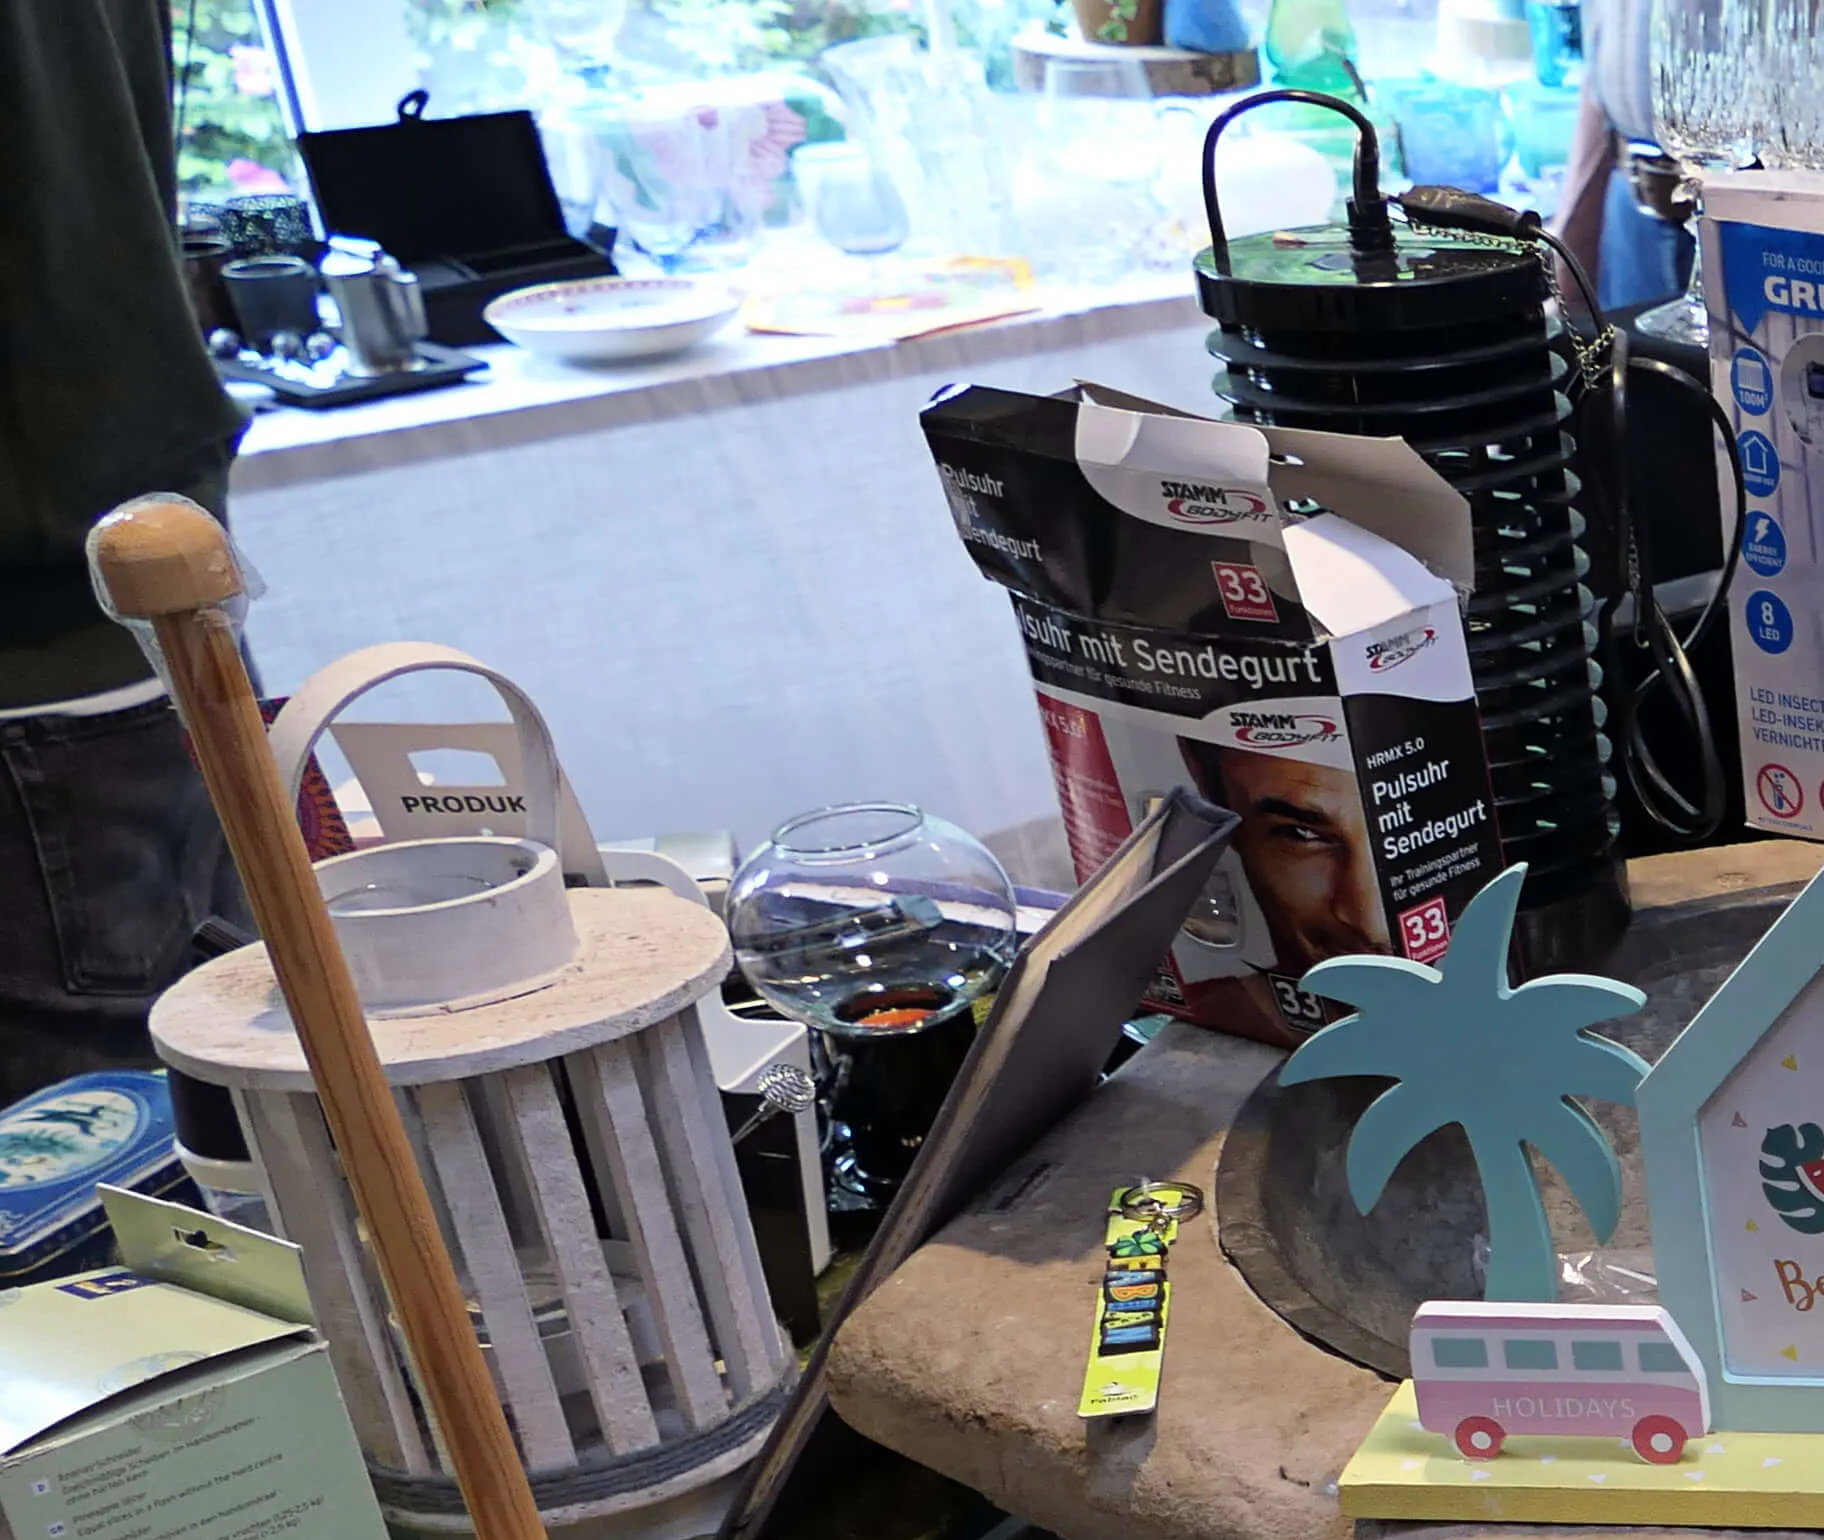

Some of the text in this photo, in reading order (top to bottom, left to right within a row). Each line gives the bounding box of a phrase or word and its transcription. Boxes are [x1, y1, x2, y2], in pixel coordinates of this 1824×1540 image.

[1762, 252, 1785, 269] FOR
[1787, 256, 1796, 270] A
[1161, 481, 1228, 505] STAMM
[1186, 503, 1274, 524] BODYFIT
[1218, 568, 1268, 603] 33
[1761, 601, 1774, 625] 8
[1759, 627, 1780, 642] LED
[1079, 634, 1127, 669] mit
[1133, 640, 1320, 690] Sendegurt
[1155, 680, 1201, 701] Fitness
[1750, 687, 1775, 705] LED
[1230, 712, 1296, 729] STAMM
[1254, 731, 1345, 743] BODYFIT
[1367, 738, 1425, 769] HRMX 5.0
[1372, 760, 1450, 805] Pulsuhr
[1379, 804, 1414, 832] mit
[1384, 800, 1487, 860] Sendegurt
[1390, 842, 1480, 888] Ihr Trainingspartner
[1394, 857, 1480, 901] für gesunde Fitness
[1405, 907, 1445, 948] 33
[1493, 1397, 1636, 1419] HOLIDAYS
